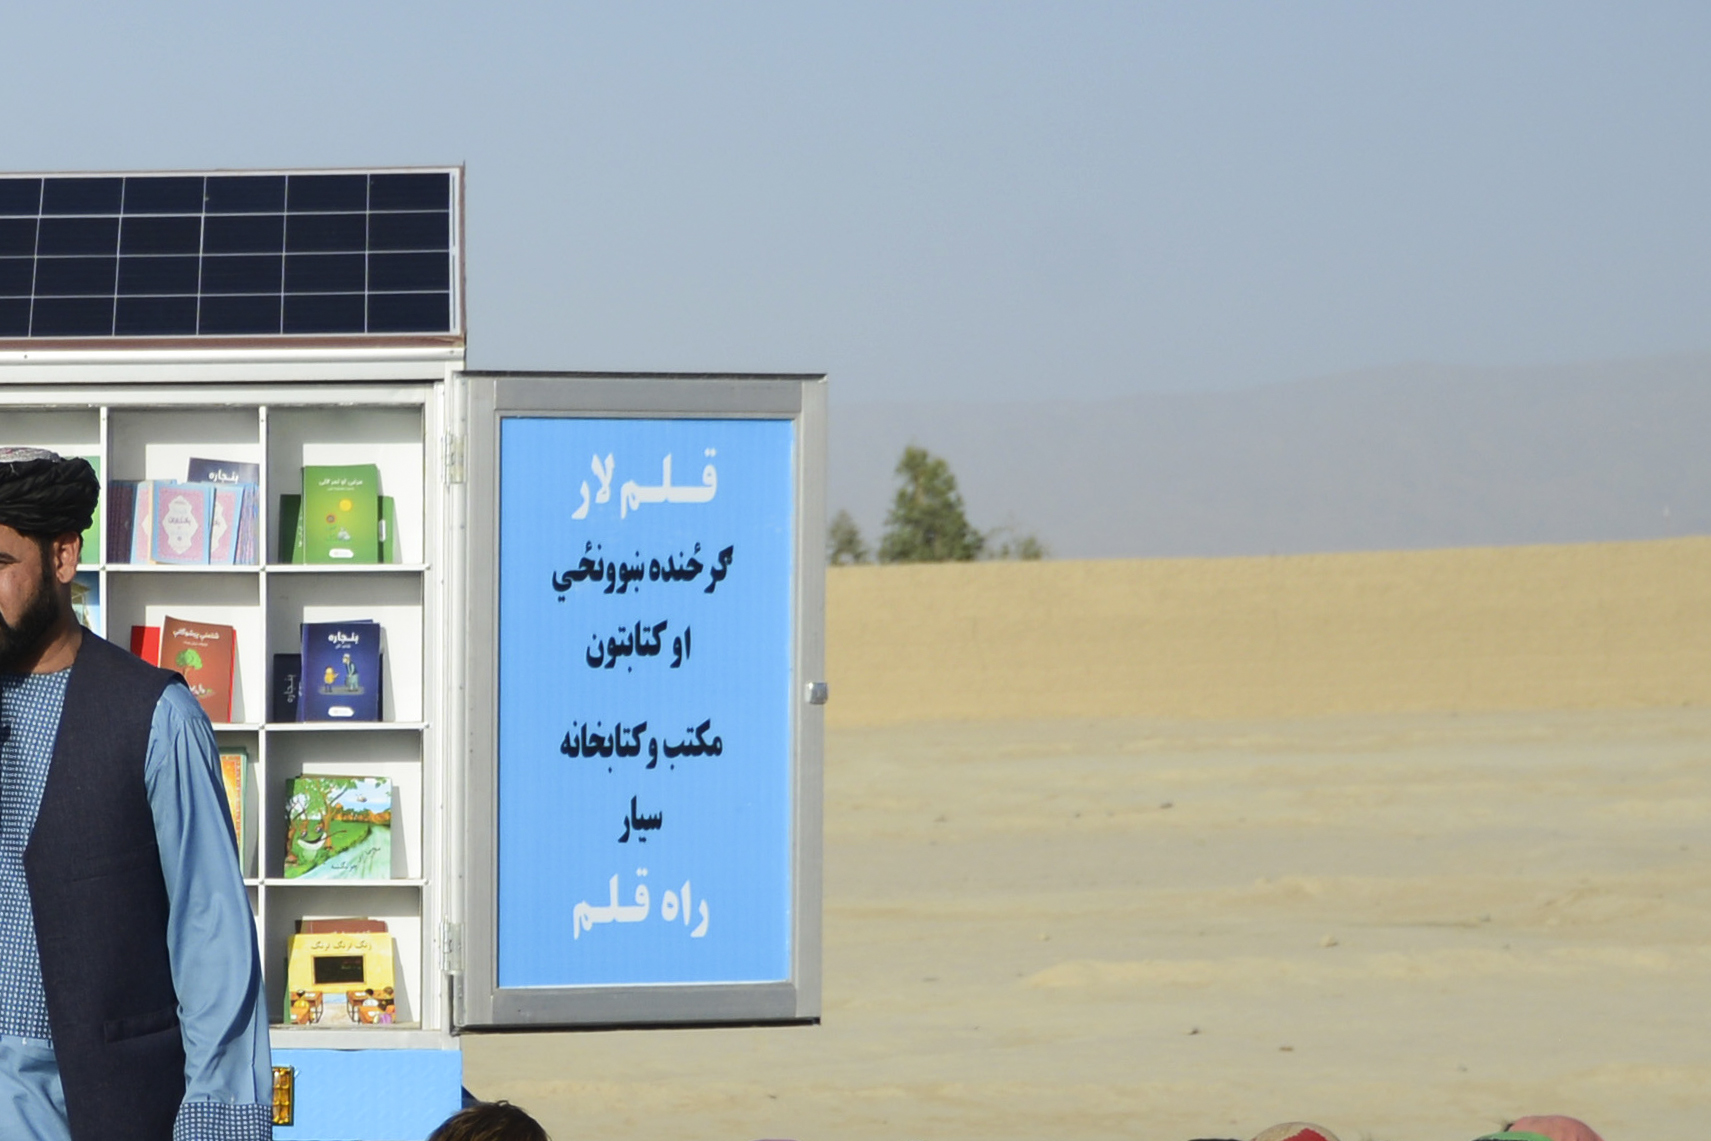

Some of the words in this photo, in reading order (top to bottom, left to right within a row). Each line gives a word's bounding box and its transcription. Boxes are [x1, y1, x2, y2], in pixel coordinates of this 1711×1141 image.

[571, 451, 615, 520] لار
[621, 447, 718, 520] قلم
[585, 619, 669, 674] کتابتون
[669, 625, 692, 669] او
[662, 718, 723, 771] مکتب
[617, 794, 663, 843] سیار
[573, 867, 650, 940] قلم
[661, 879, 710, 938] راه
